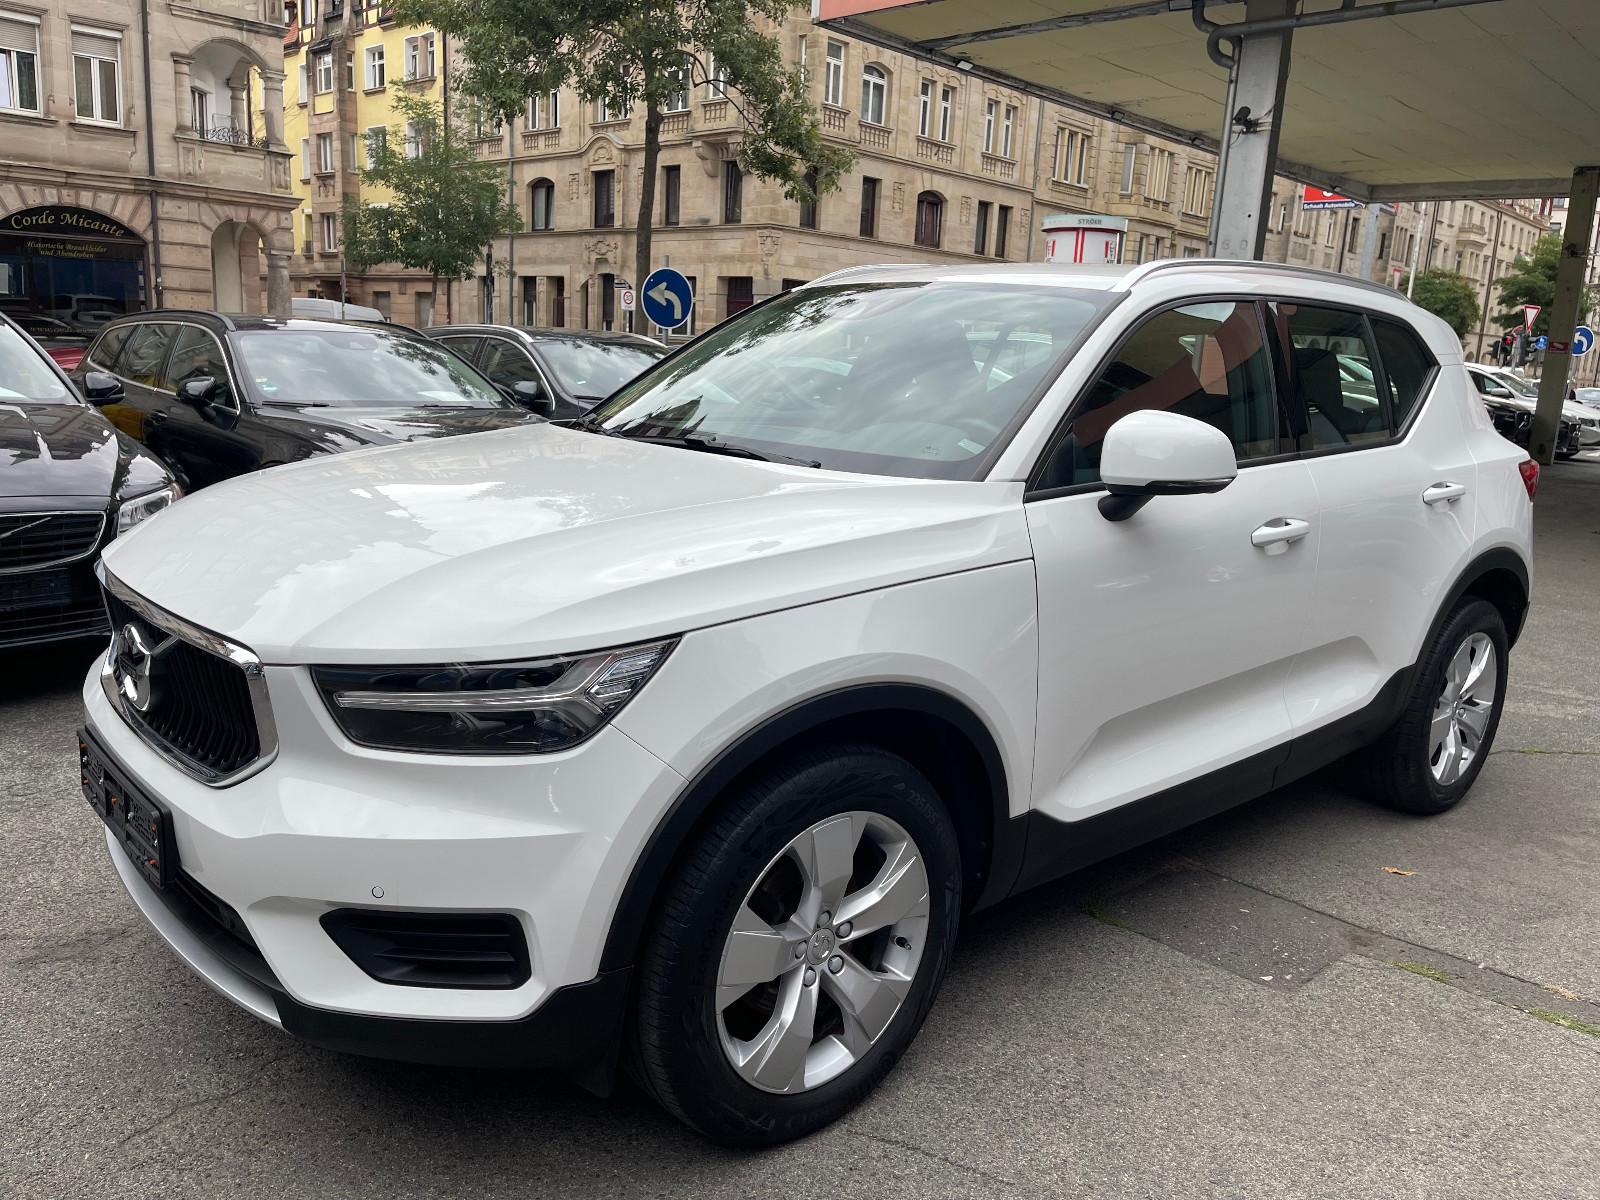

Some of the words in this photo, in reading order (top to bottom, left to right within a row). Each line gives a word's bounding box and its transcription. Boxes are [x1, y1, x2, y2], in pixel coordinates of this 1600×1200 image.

[11, 210, 55, 229] Corde
[60, 213, 125, 237] Micante
[26, 240, 65, 250] Historische
